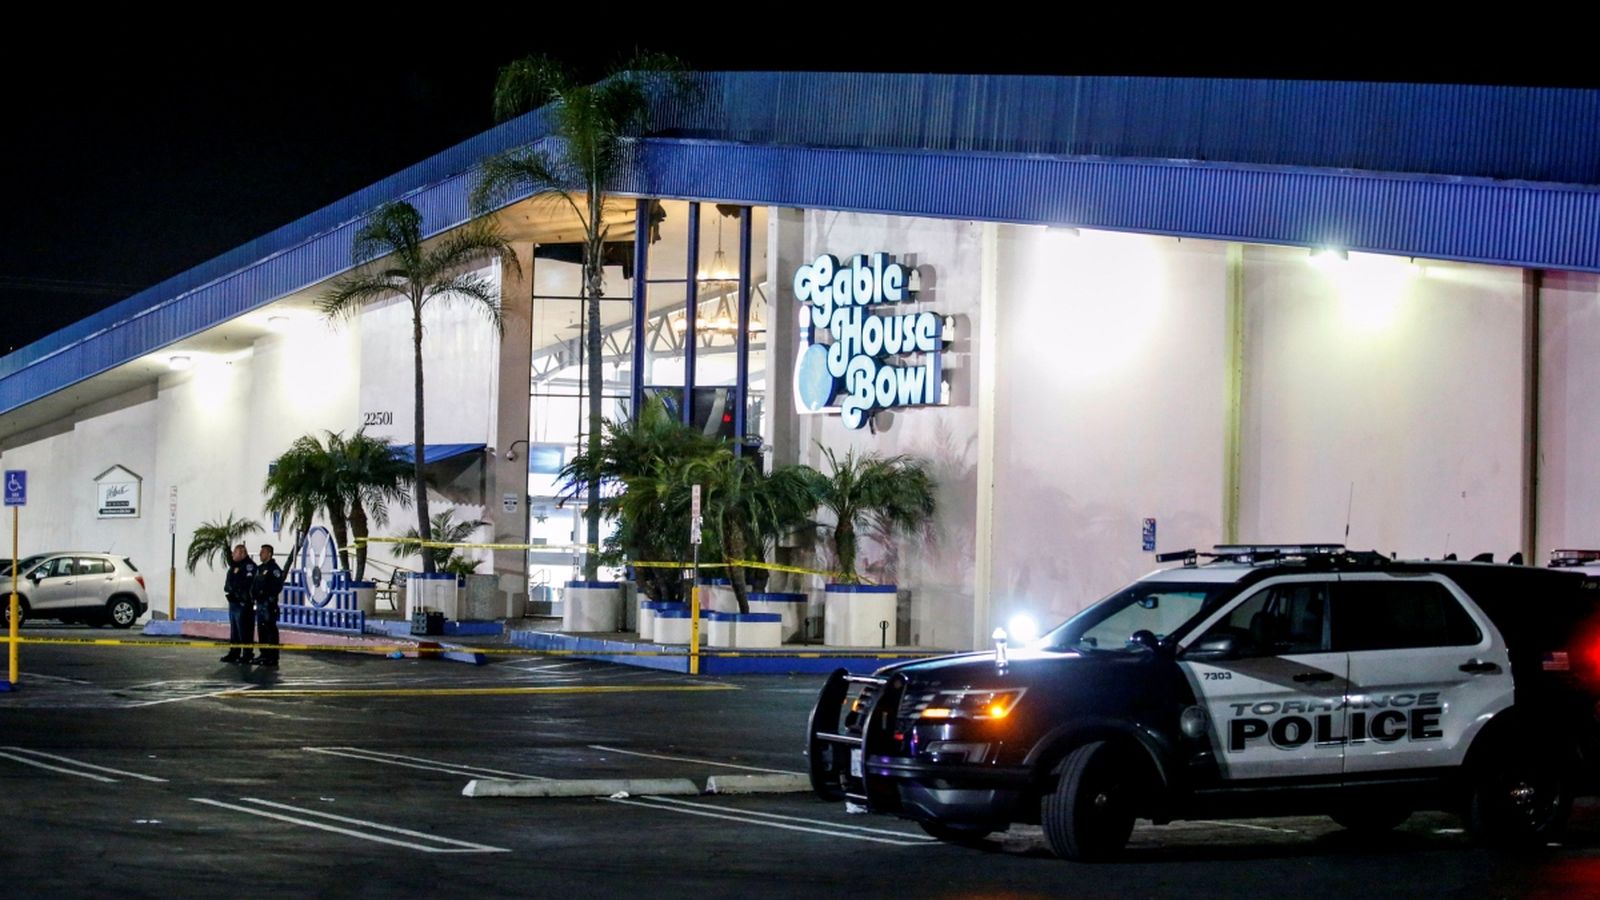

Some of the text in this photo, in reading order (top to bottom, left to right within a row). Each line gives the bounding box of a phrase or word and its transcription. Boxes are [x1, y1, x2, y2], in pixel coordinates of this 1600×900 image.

[794, 252, 906, 328] Gable
[828, 307, 940, 378] House
[841, 352, 939, 430] Bowl
[364, 411, 393, 426] 22501
[1203, 672, 1232, 681] 7303
[1229, 692, 1441, 716] TORRANCE
[1228, 707, 1444, 753] POLICE
